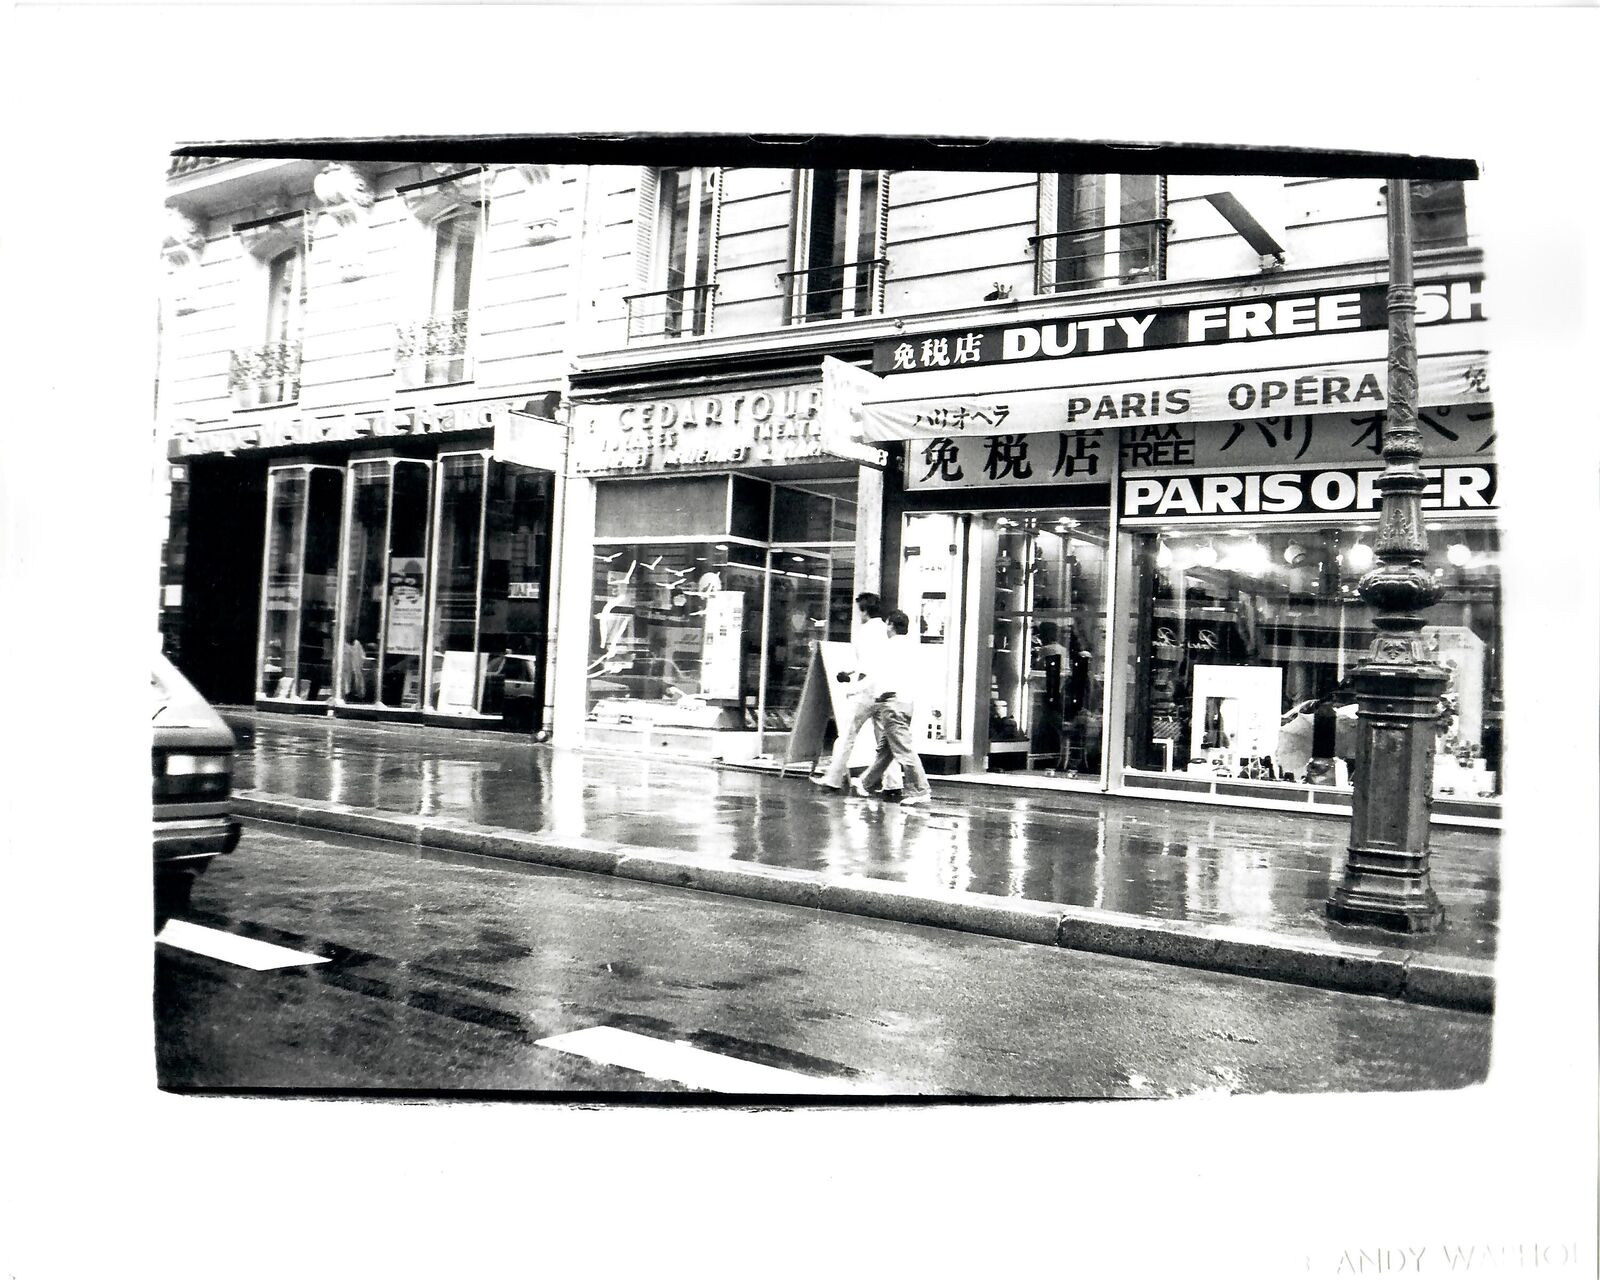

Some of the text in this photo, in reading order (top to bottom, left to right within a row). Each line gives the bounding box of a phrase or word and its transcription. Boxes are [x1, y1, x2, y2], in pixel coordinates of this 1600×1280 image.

[1002, 313, 1156, 360] DUTY
[1187, 293, 1362, 343] FREE
[893, 332, 984, 370] 免税店
[1067, 373, 1385, 423] PARIS OPÉRA
[1122, 440, 1194, 466] FREE
[1127, 424, 1183, 441] TAX
[919, 430, 1105, 482] 免税店
